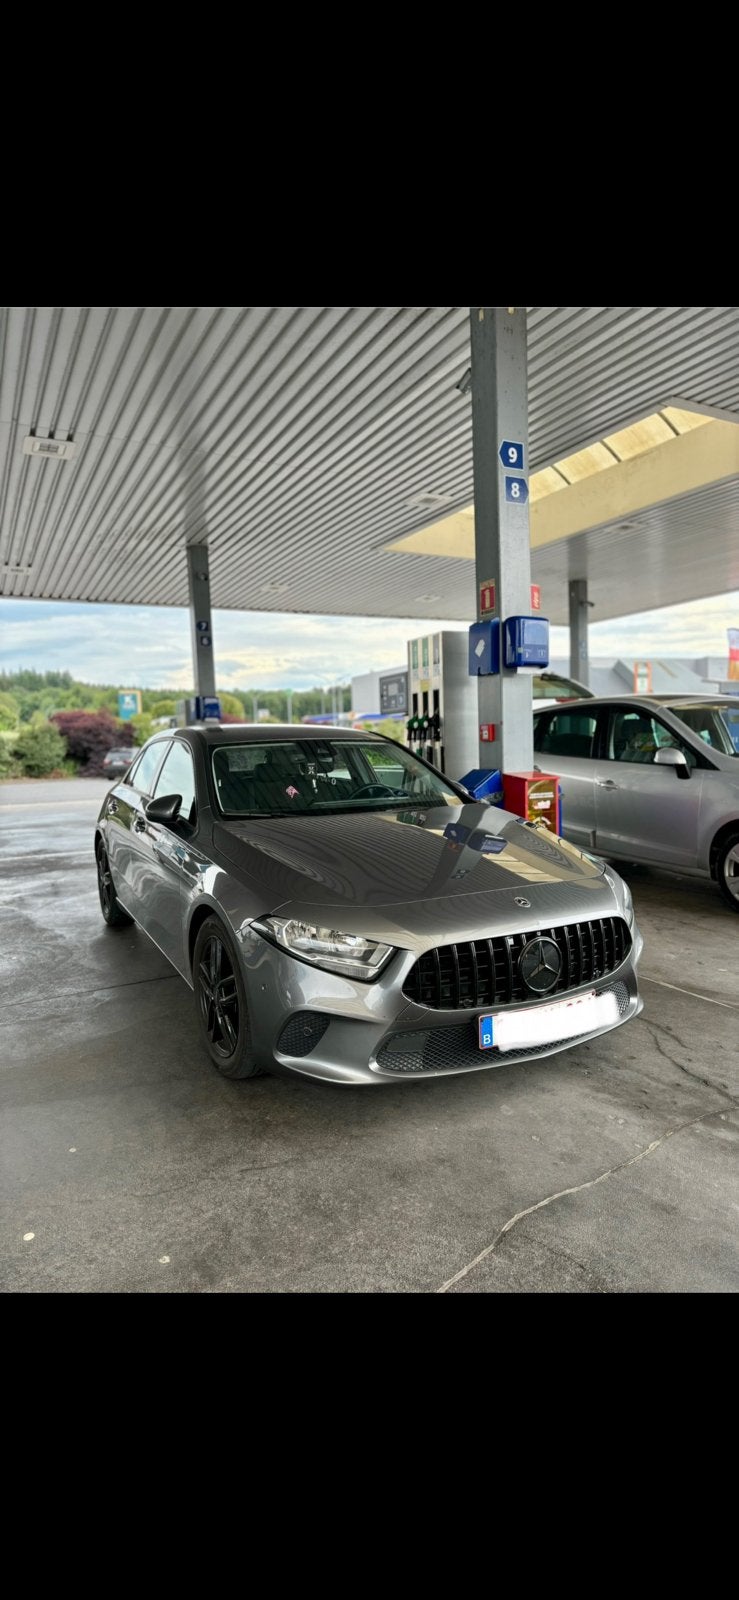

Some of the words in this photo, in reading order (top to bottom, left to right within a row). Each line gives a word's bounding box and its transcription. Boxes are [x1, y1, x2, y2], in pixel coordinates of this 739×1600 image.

[508, 447, 518, 463] 9
[511, 482, 520, 498] 8
[483, 1034, 491, 1044] B
